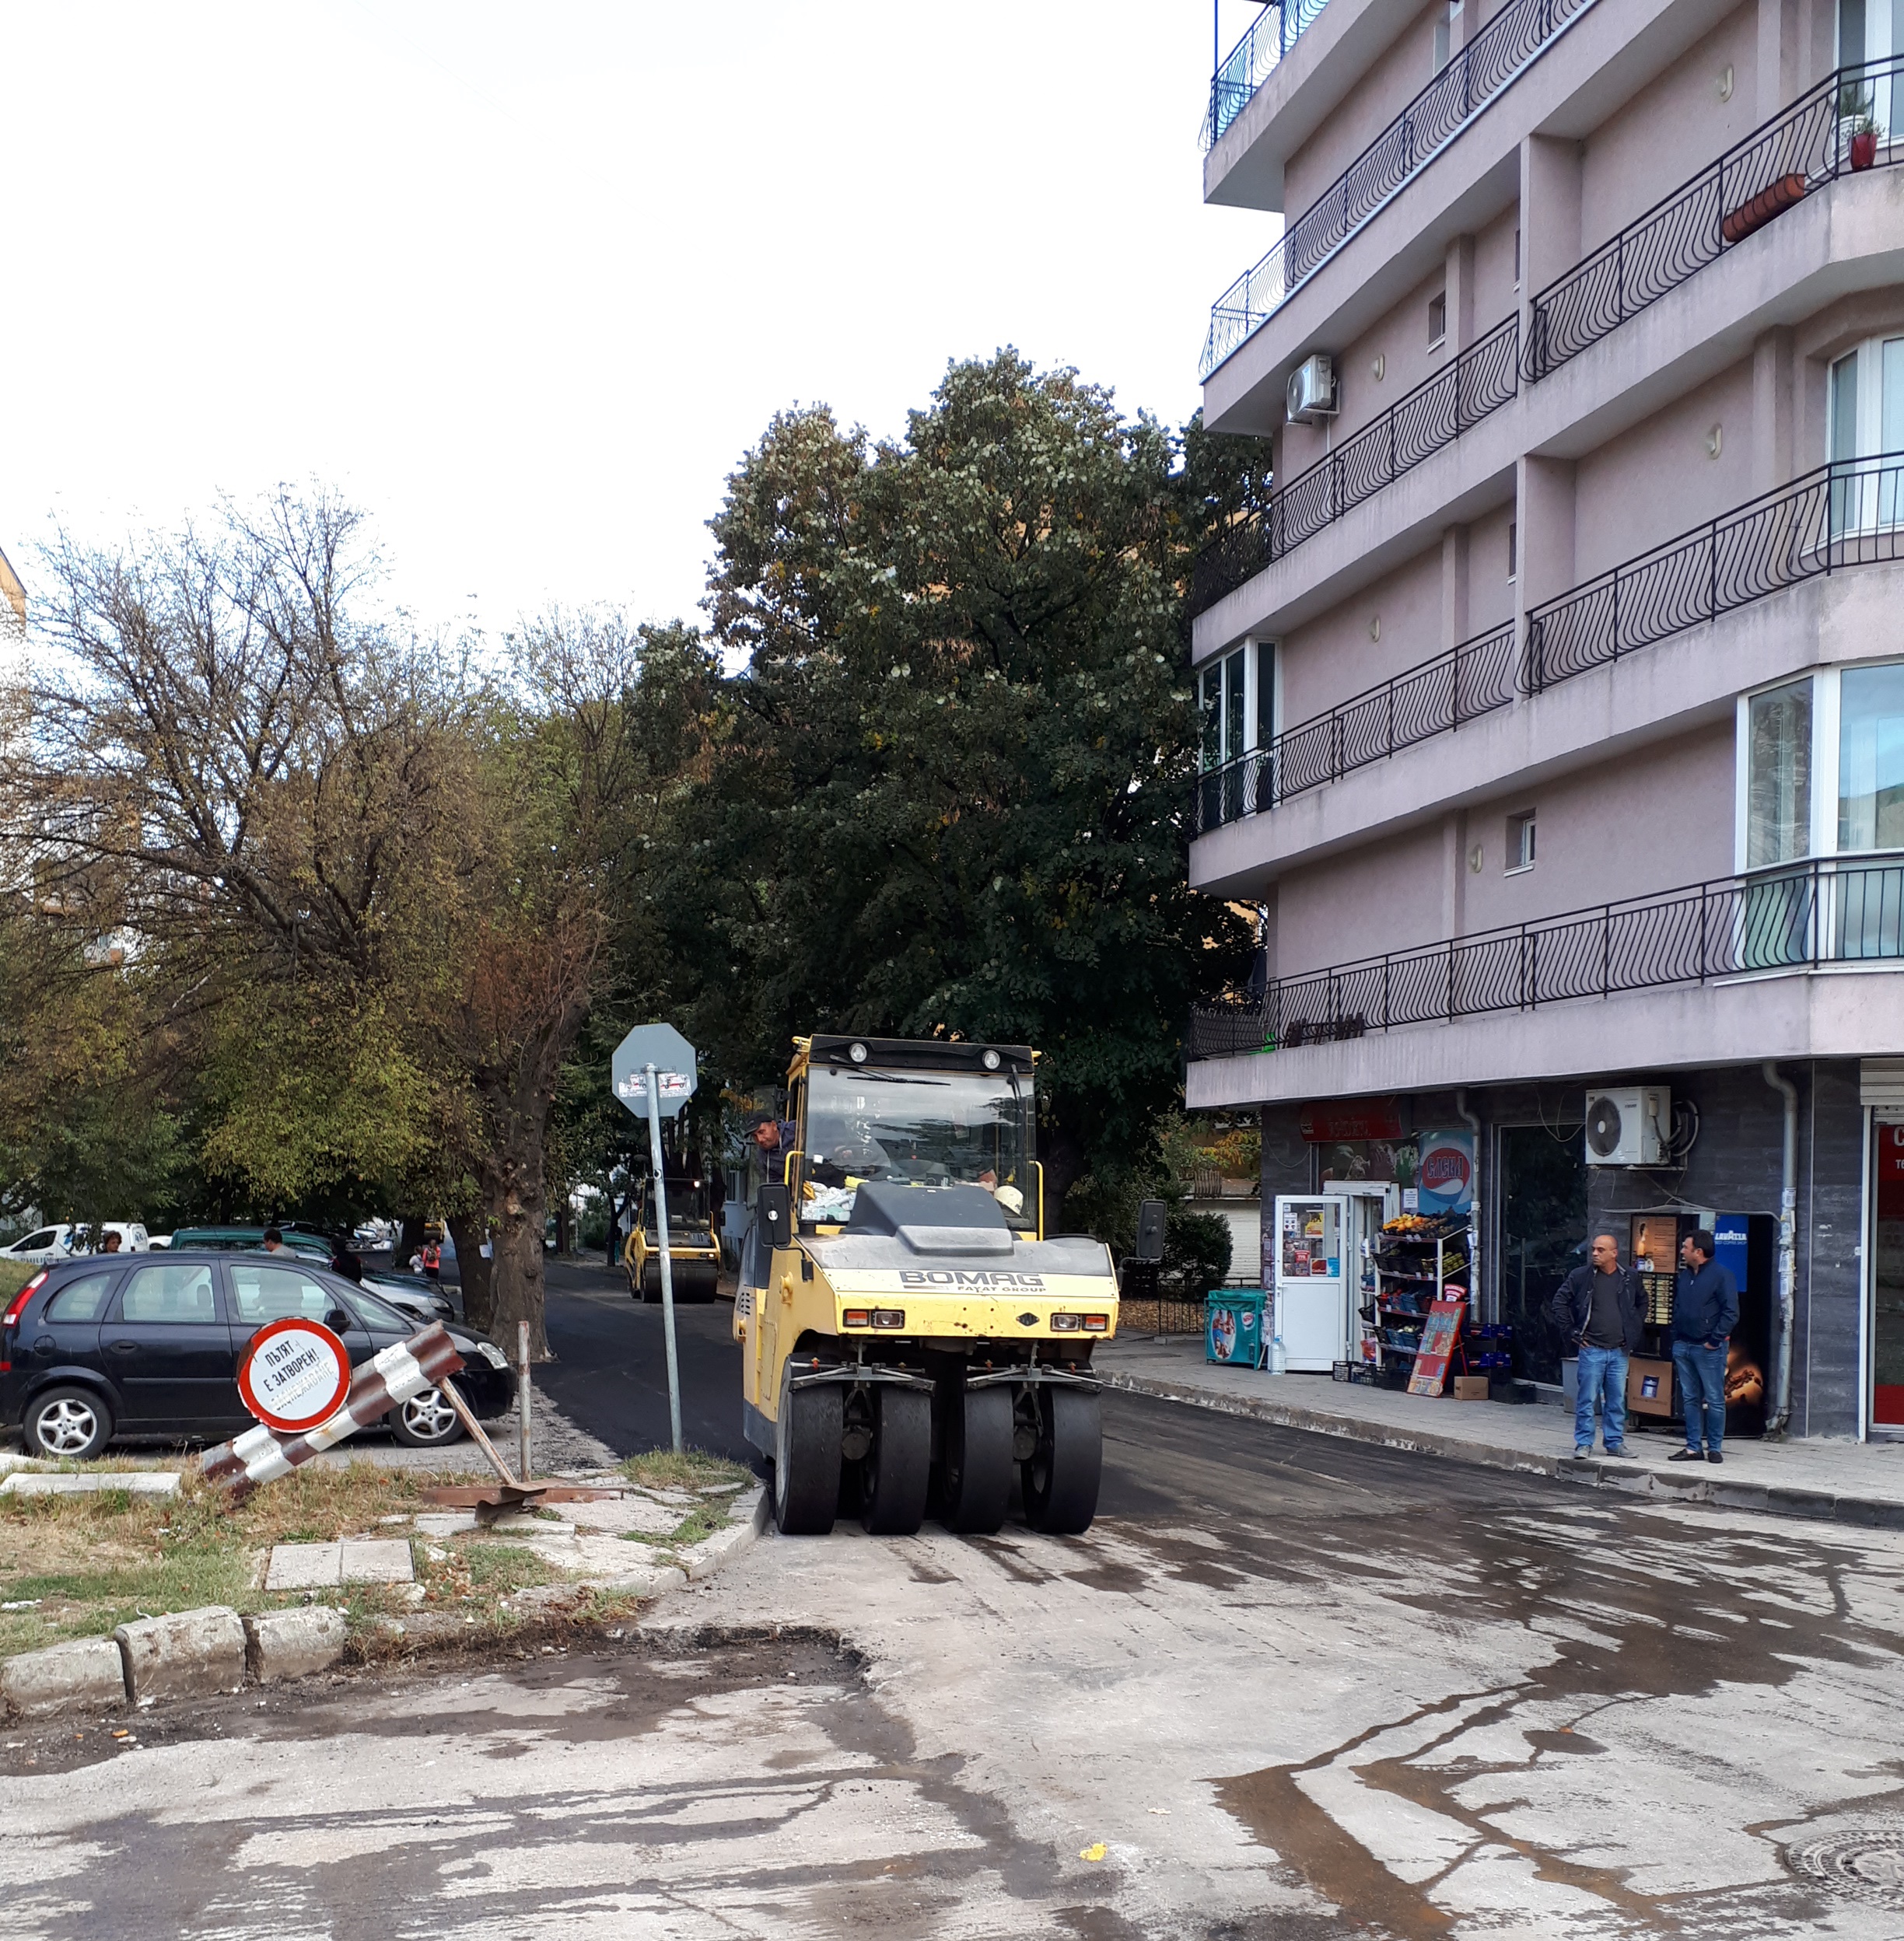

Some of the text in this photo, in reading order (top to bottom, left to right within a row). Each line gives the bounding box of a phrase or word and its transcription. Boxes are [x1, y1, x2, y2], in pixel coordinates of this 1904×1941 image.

[1714, 1230, 1747, 1240] LAVAZZA
[898, 1271, 1045, 1286] BOMAG
[264, 1340, 295, 1367] ПЪТЯТ
[263, 1348, 320, 1392] Е ЗАТВОРЕН!
